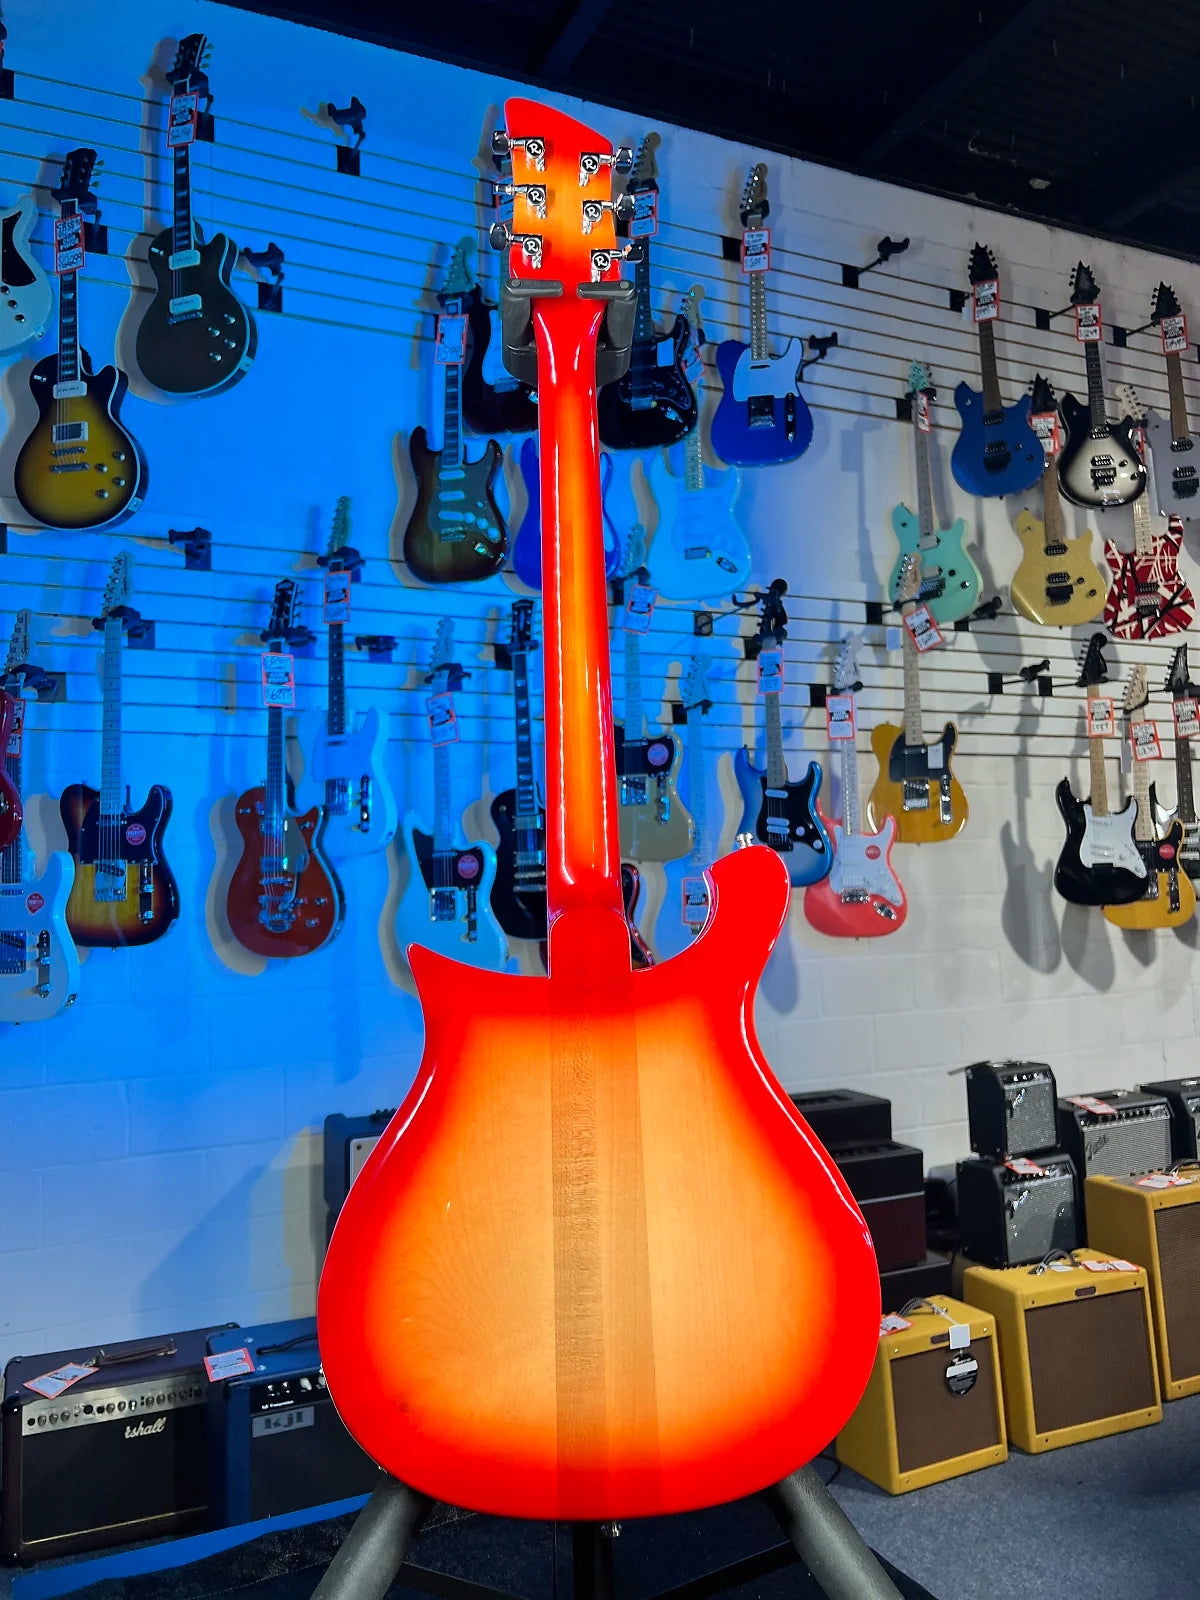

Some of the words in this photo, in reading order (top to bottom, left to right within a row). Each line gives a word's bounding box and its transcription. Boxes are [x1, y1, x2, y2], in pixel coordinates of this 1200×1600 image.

[530, 144, 541, 154] R
[585, 159, 597, 170] R
[531, 191, 542, 201] R
[587, 207, 599, 217] R
[527, 242, 539, 252] R
[596, 256, 608, 267] R
